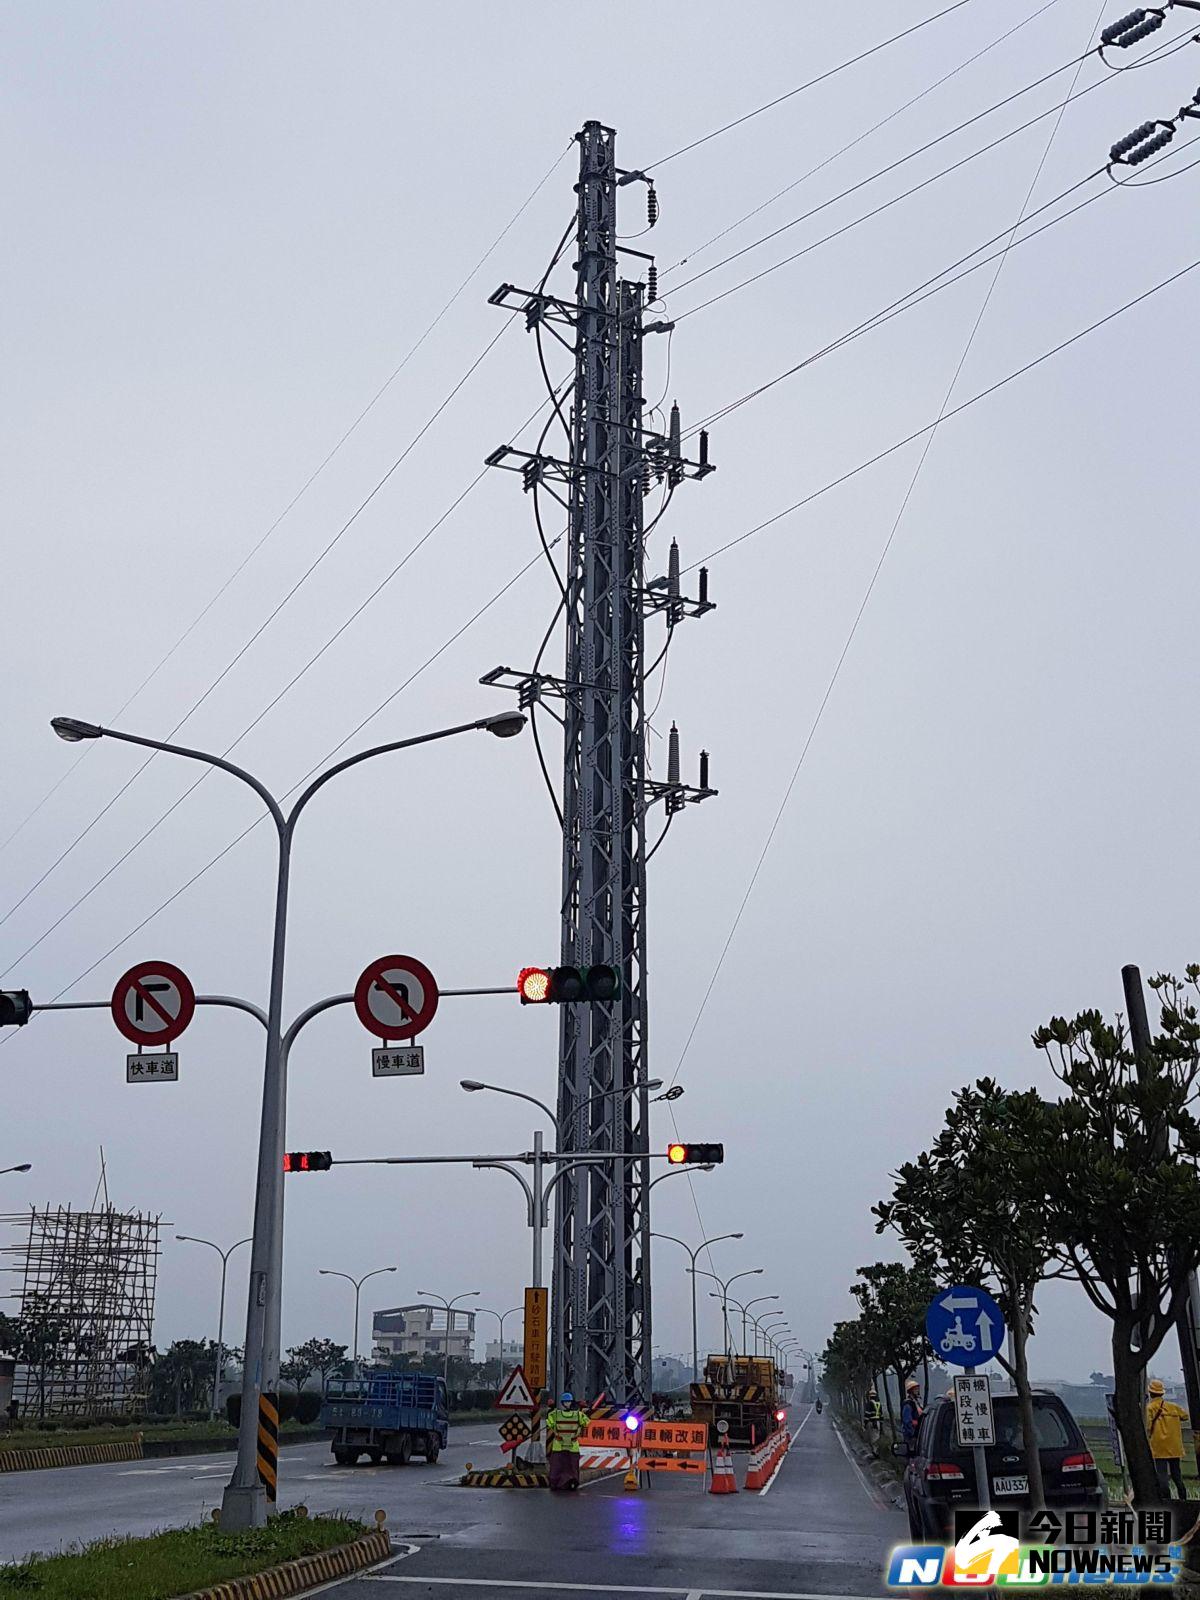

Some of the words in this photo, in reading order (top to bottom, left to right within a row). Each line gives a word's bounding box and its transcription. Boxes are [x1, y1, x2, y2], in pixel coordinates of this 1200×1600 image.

[130, 1060, 175, 1076] 快車道
[376, 1053, 421, 1070] 慢車道
[957, 1378, 975, 1441] 兩段左轉
[973, 1378, 991, 1441] 機慢車
[580, 1427, 629, 1441] 車輛慢
[644, 1428, 704, 1444] 車輛改道
